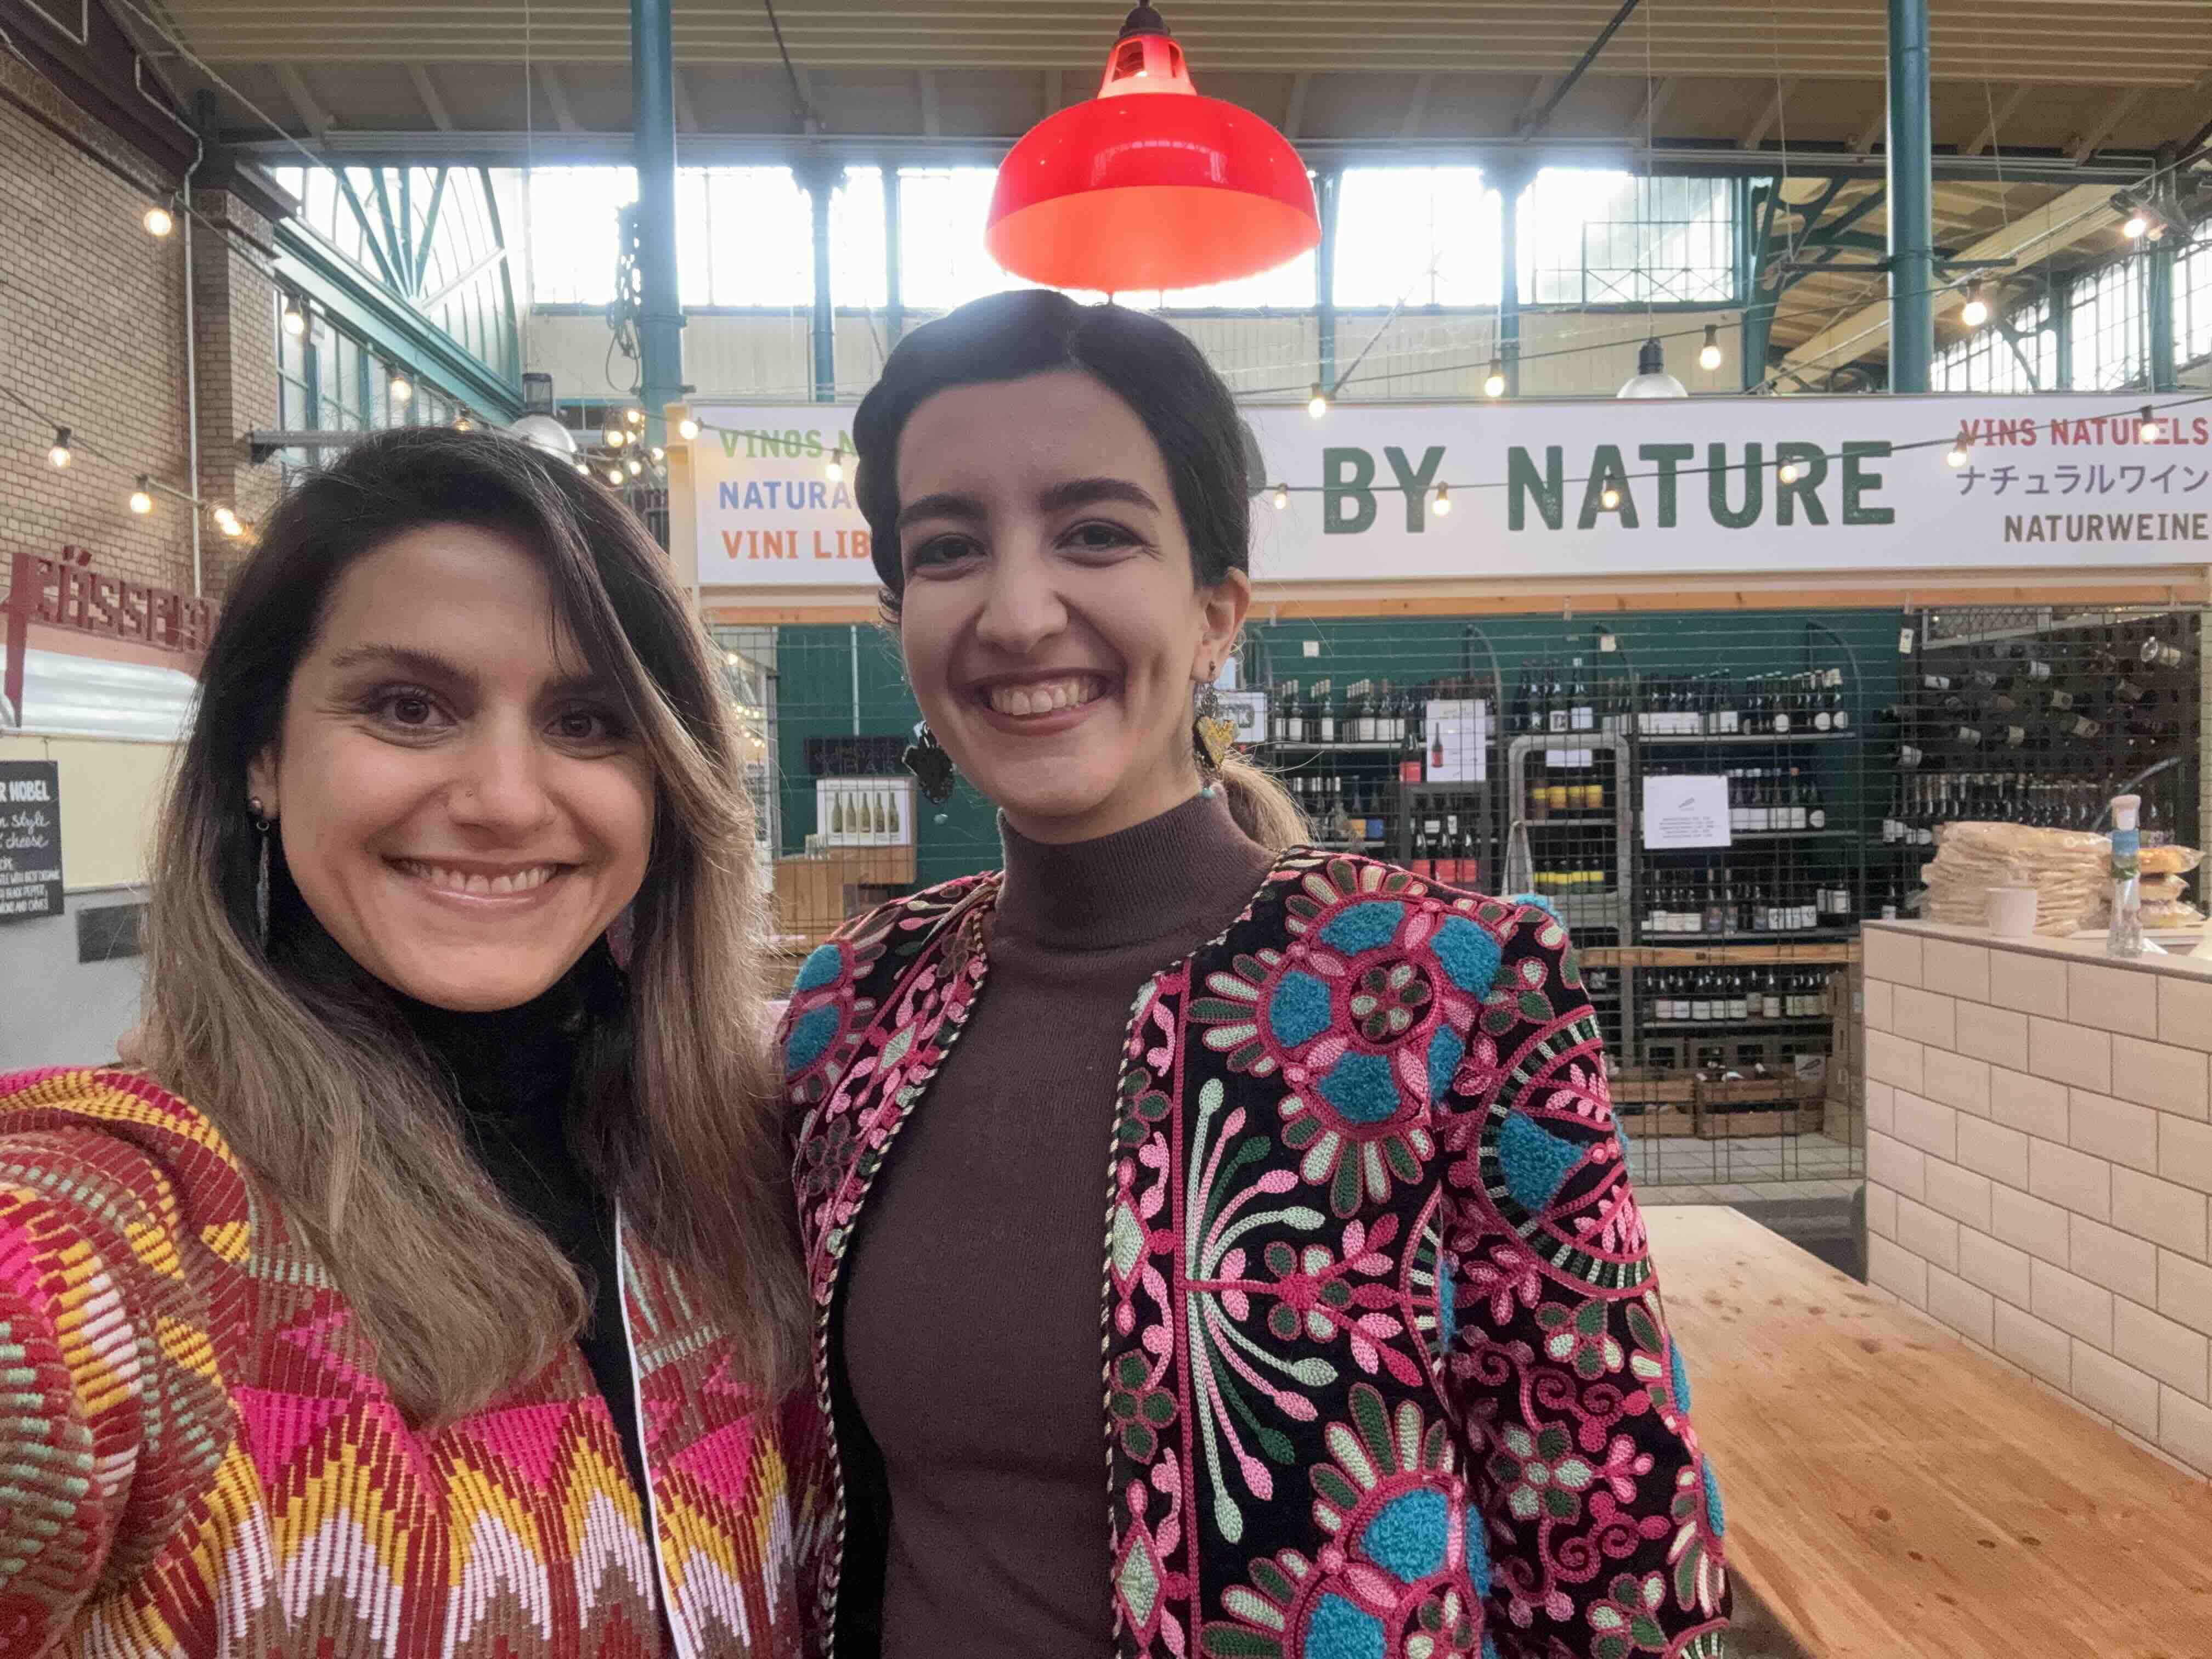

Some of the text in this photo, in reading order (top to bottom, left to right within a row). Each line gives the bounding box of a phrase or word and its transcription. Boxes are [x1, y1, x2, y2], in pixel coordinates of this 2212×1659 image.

[718, 430, 823, 459] VINOS
[1959, 417, 2210, 446] VINS NATURELS
[1322, 440, 1895, 535] BY NATURE
[1956, 465, 2210, 496] ナチュラルワイン
[2004, 513, 2209, 543] NATURWEINE
[720, 529, 799, 560] VINI
[11, 810, 52, 836] style
[5, 831, 49, 850] cheese
